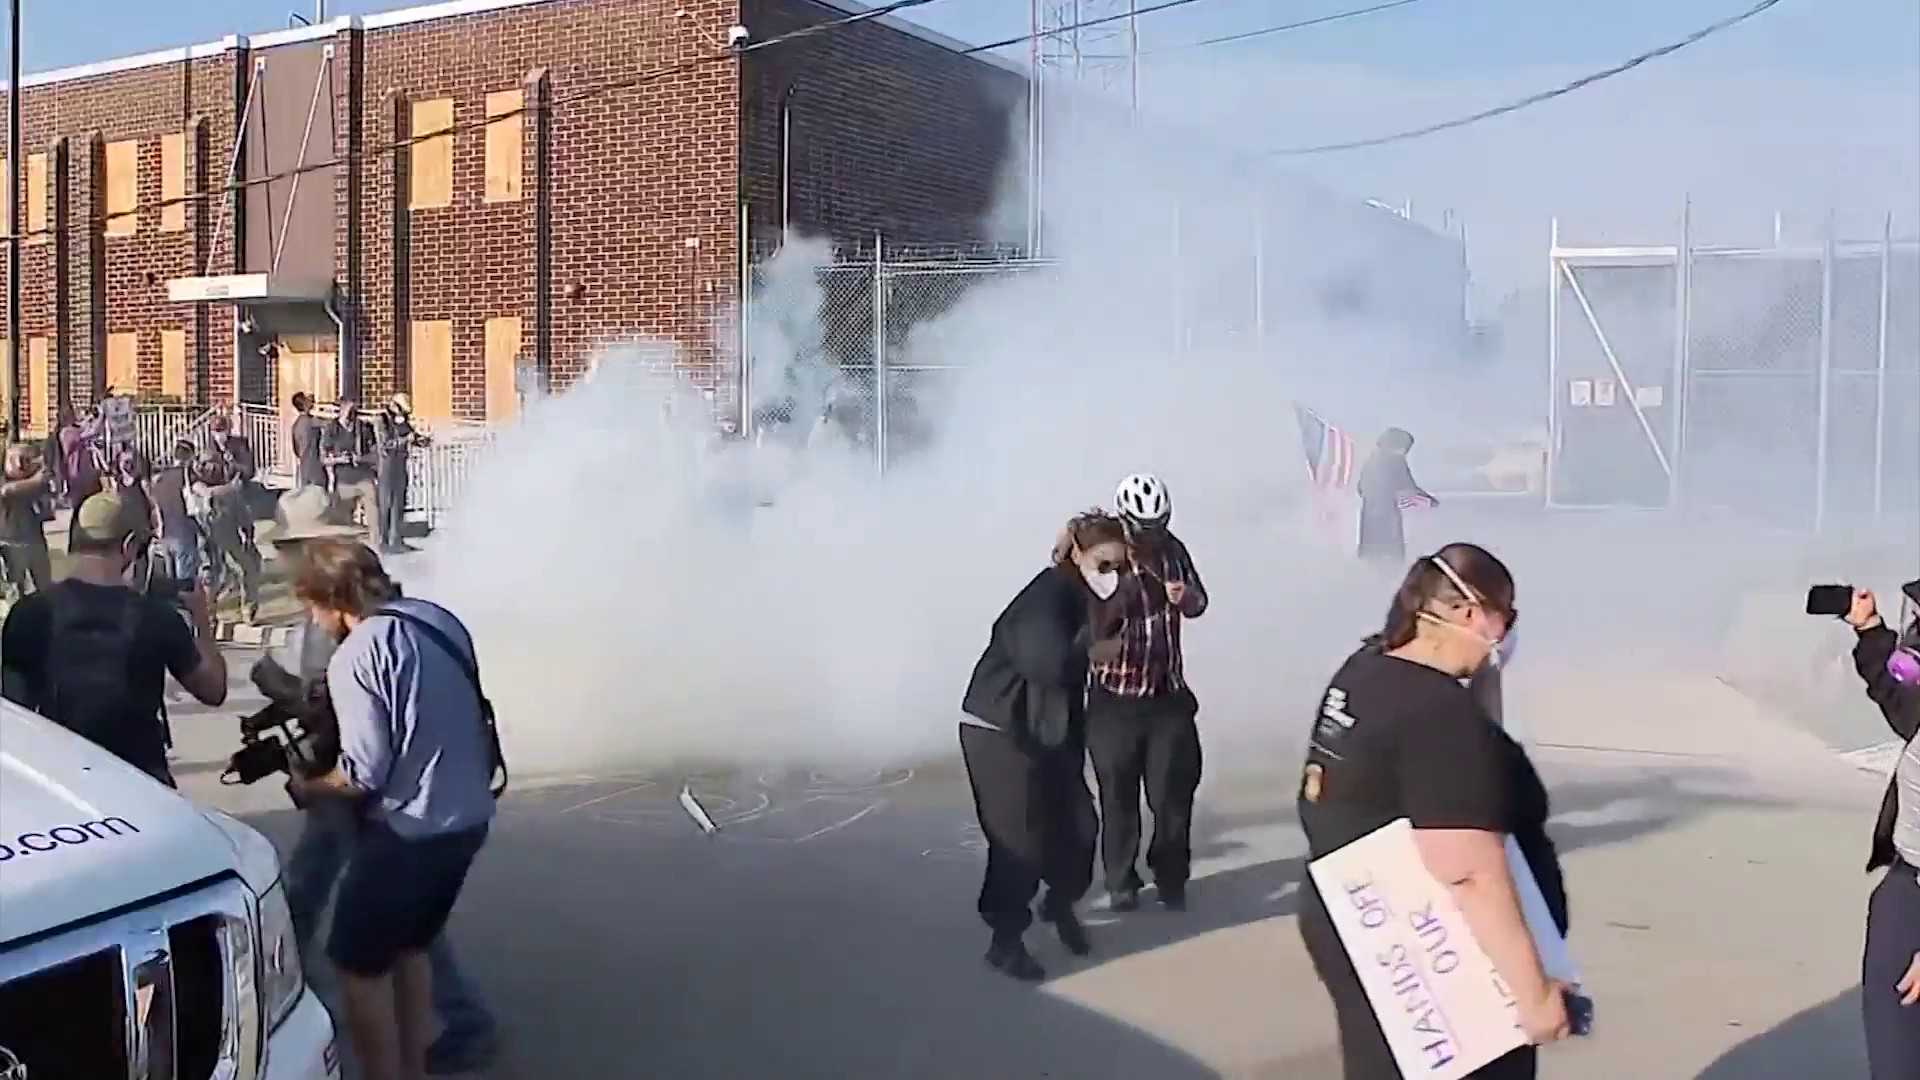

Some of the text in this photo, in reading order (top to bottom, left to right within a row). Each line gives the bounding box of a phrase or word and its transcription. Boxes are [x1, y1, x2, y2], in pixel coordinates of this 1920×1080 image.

[1344, 870, 1454, 1070] HANDS OFF
[1409, 900, 1459, 975] OUR
